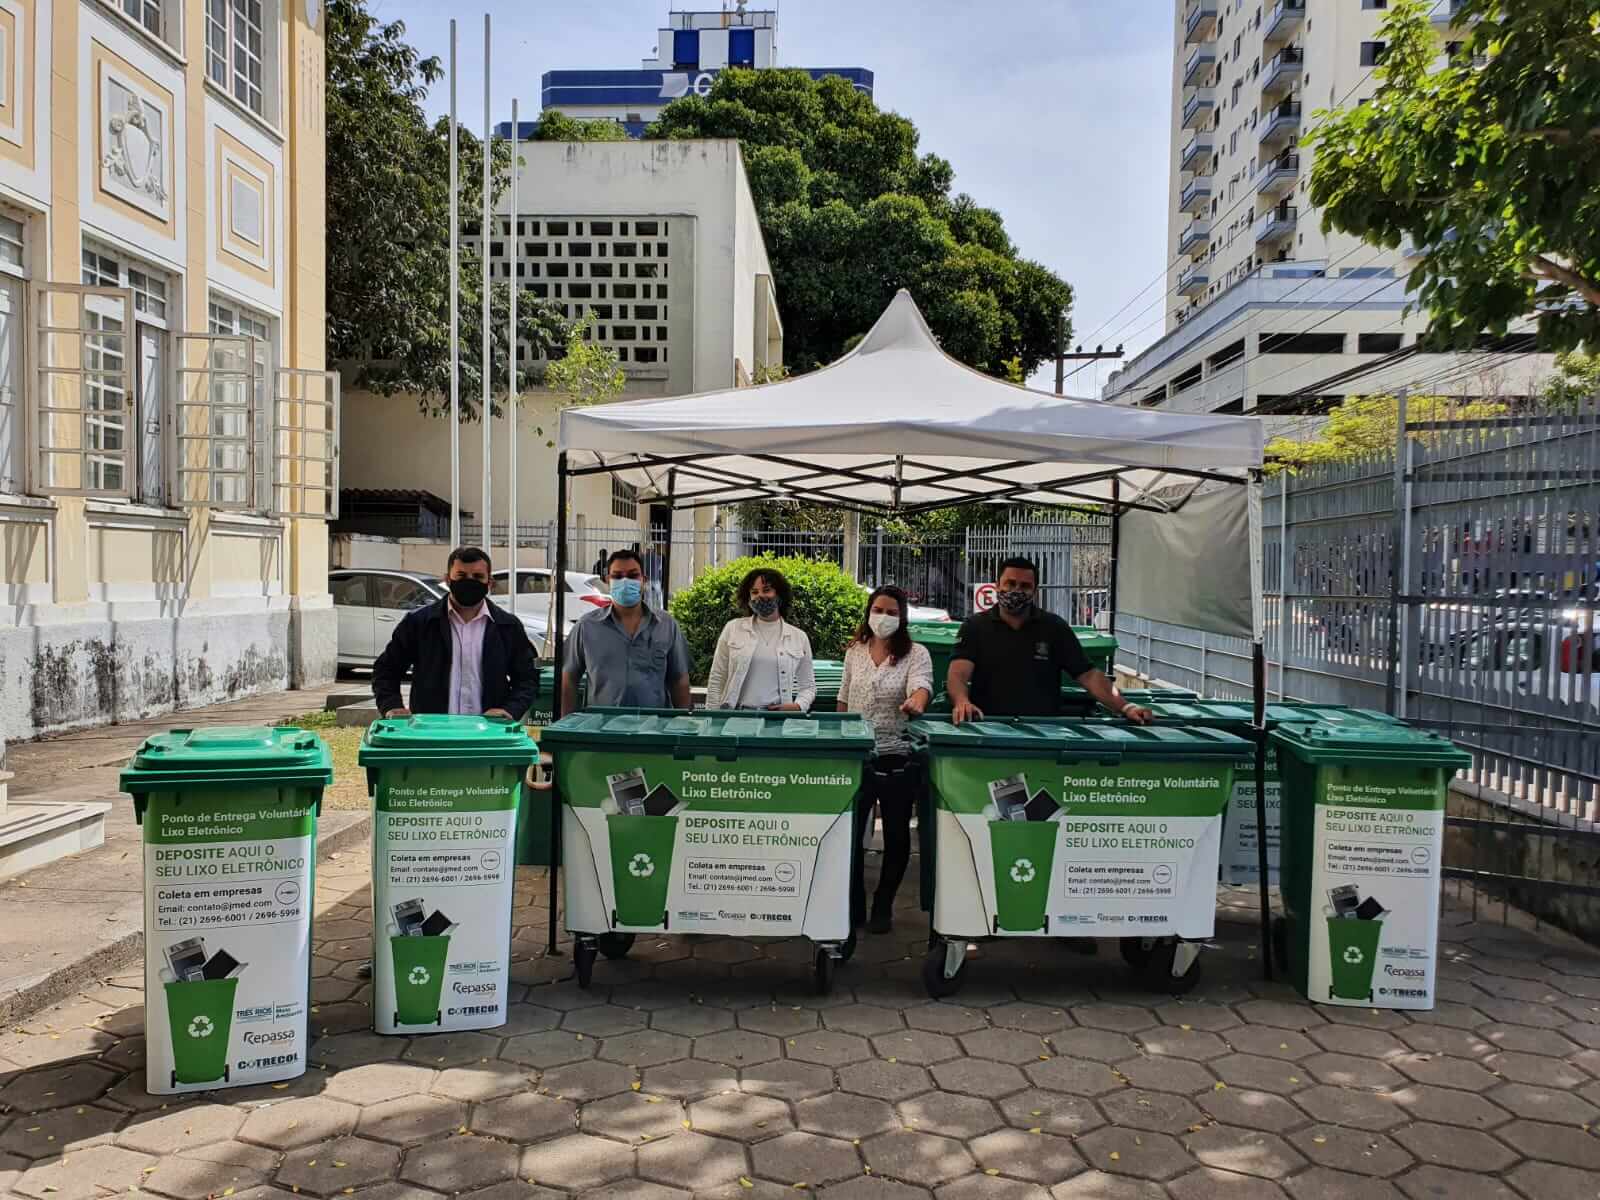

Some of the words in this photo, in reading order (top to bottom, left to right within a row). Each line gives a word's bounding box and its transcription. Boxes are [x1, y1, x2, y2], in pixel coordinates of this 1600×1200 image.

[682, 771, 718, 783] Ponto
[721, 772, 736, 783] de
[740, 773, 786, 786] Entrega
[790, 774, 852, 785] Voluntária
[1064, 776, 1096, 787] Ponto
[1101, 777, 1113, 787] de
[1117, 778, 1160, 790] Entrega
[1164, 778, 1219, 788] Voluntária
[417, 787, 426, 795] de
[430, 788, 463, 797] Entrega
[466, 787, 509, 795] Voluntária
[682, 787, 707, 798] Lixo
[711, 787, 771, 799] Eletrônico
[1063, 792, 1086, 802] Lixo
[1090, 793, 1146, 803] Eletrônico
[409, 799, 453, 807] Eletrônico
[162, 814, 194, 823] Ponto
[198, 813, 211, 822] de
[214, 811, 256, 823] Entrega
[259, 808, 310, 819] Voluntária
[389, 817, 443, 826] DEPOSITE
[446, 817, 471, 826] AQUI
[475, 817, 482, 825] O
[1327, 810, 1376, 821] DEPOSITE
[1379, 813, 1403, 822] AQUI
[1407, 814, 1413, 822] O
[686, 818, 745, 829] DEPOSITE
[748, 820, 777, 830] AQUI
[781, 820, 789, 830] O
[1067, 823, 1124, 832] DEPOSITE
[1128, 824, 1155, 834] AQUI
[1160, 824, 1167, 833] O
[1326, 823, 1345, 831] SEU
[1348, 824, 1371, 832] LIXO
[1375, 825, 1435, 835] ELETRÔNICO
[162, 827, 184, 837] Lixo
[188, 825, 243, 835] Eletrônico
[388, 832, 408, 840] SEU
[412, 831, 436, 840] LIXO
[440, 829, 506, 840] ELETRÔNICO
[686, 833, 708, 843] SEU
[712, 834, 739, 844] LIXO
[743, 834, 818, 846] ELETRÔNICO
[1066, 838, 1088, 848] SEU
[1092, 838, 1118, 848] LIXO
[1122, 837, 1194, 848] ELETRÔNICO
[156, 849, 224, 860] DEPOSITE
[228, 846, 261, 858] AQUI
[265, 845, 274, 855] O
[433, 855, 470, 863] empresas
[156, 865, 182, 877] SEU
[187, 864, 217, 876] LIXO
[222, 858, 304, 874] ELETRÔNICO
[158, 890, 191, 900] Coleta
[213, 887, 262, 897] empresas
